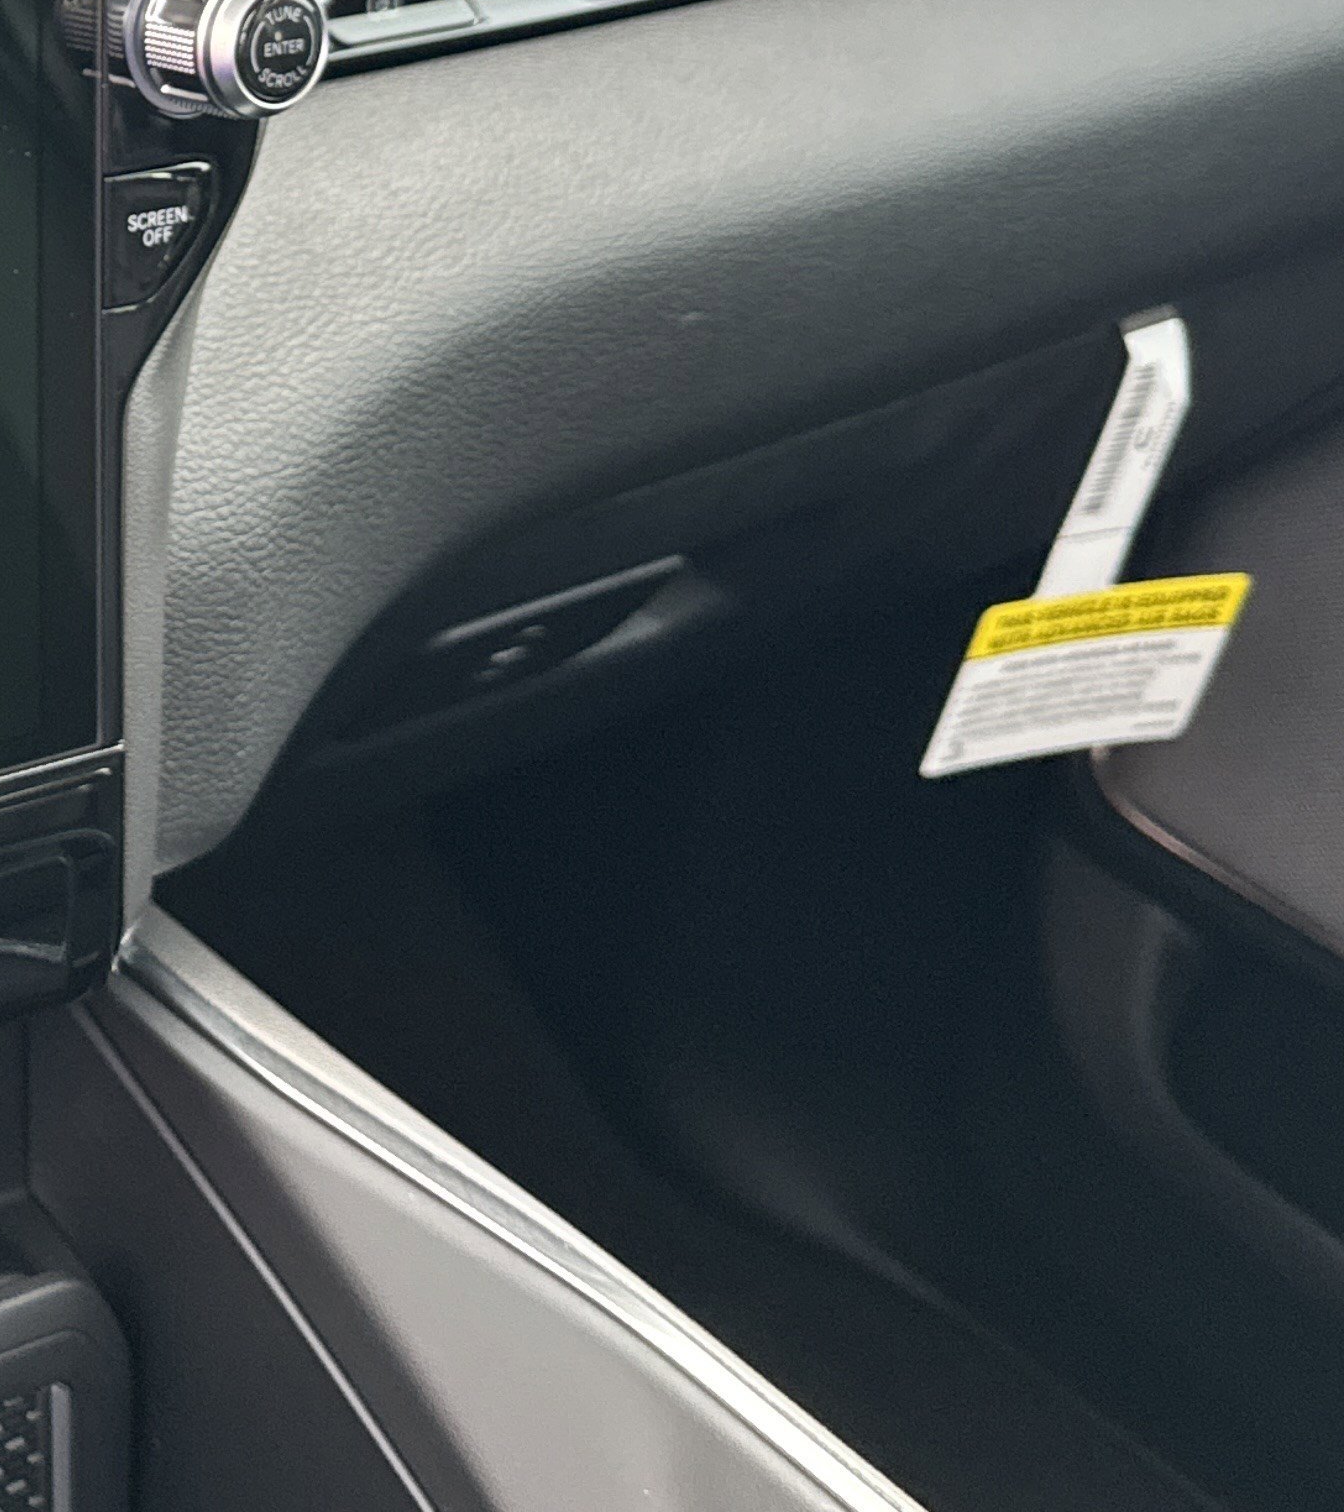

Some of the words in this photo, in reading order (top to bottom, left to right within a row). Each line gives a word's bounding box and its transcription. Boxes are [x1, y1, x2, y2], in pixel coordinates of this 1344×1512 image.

[264, 5, 302, 25] TUNE
[263, 38, 305, 57] ENTER
[258, 63, 308, 88] SCROLL
[127, 205, 188, 233] SCREEN
[142, 227, 174, 247] OFF
